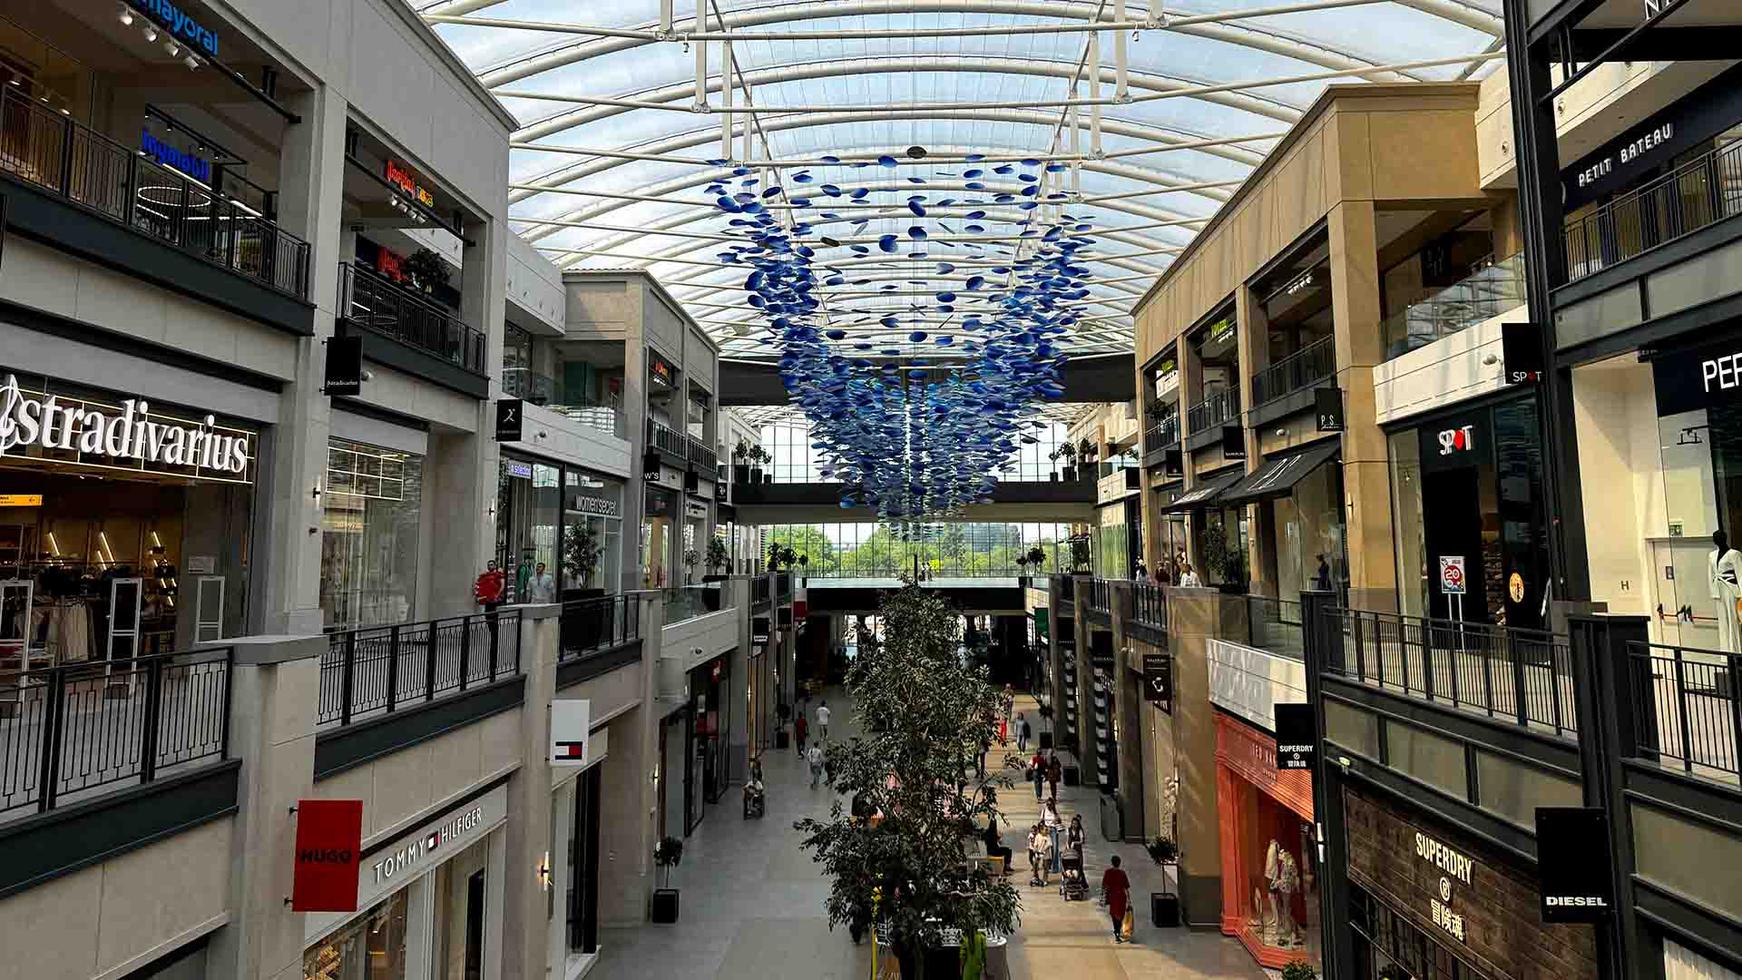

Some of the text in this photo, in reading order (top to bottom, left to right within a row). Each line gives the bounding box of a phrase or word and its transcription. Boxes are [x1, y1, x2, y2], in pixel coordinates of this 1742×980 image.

[1578, 122, 1674, 187] PETIT BATEAU
[17, 394, 248, 473] stradivarius
[301, 849, 352, 864] HUGO
[374, 806, 482, 884] TOMMY HILFIGER
[1415, 832, 1473, 885] SUPERDRY
[1546, 896, 1608, 907] DIESEL
